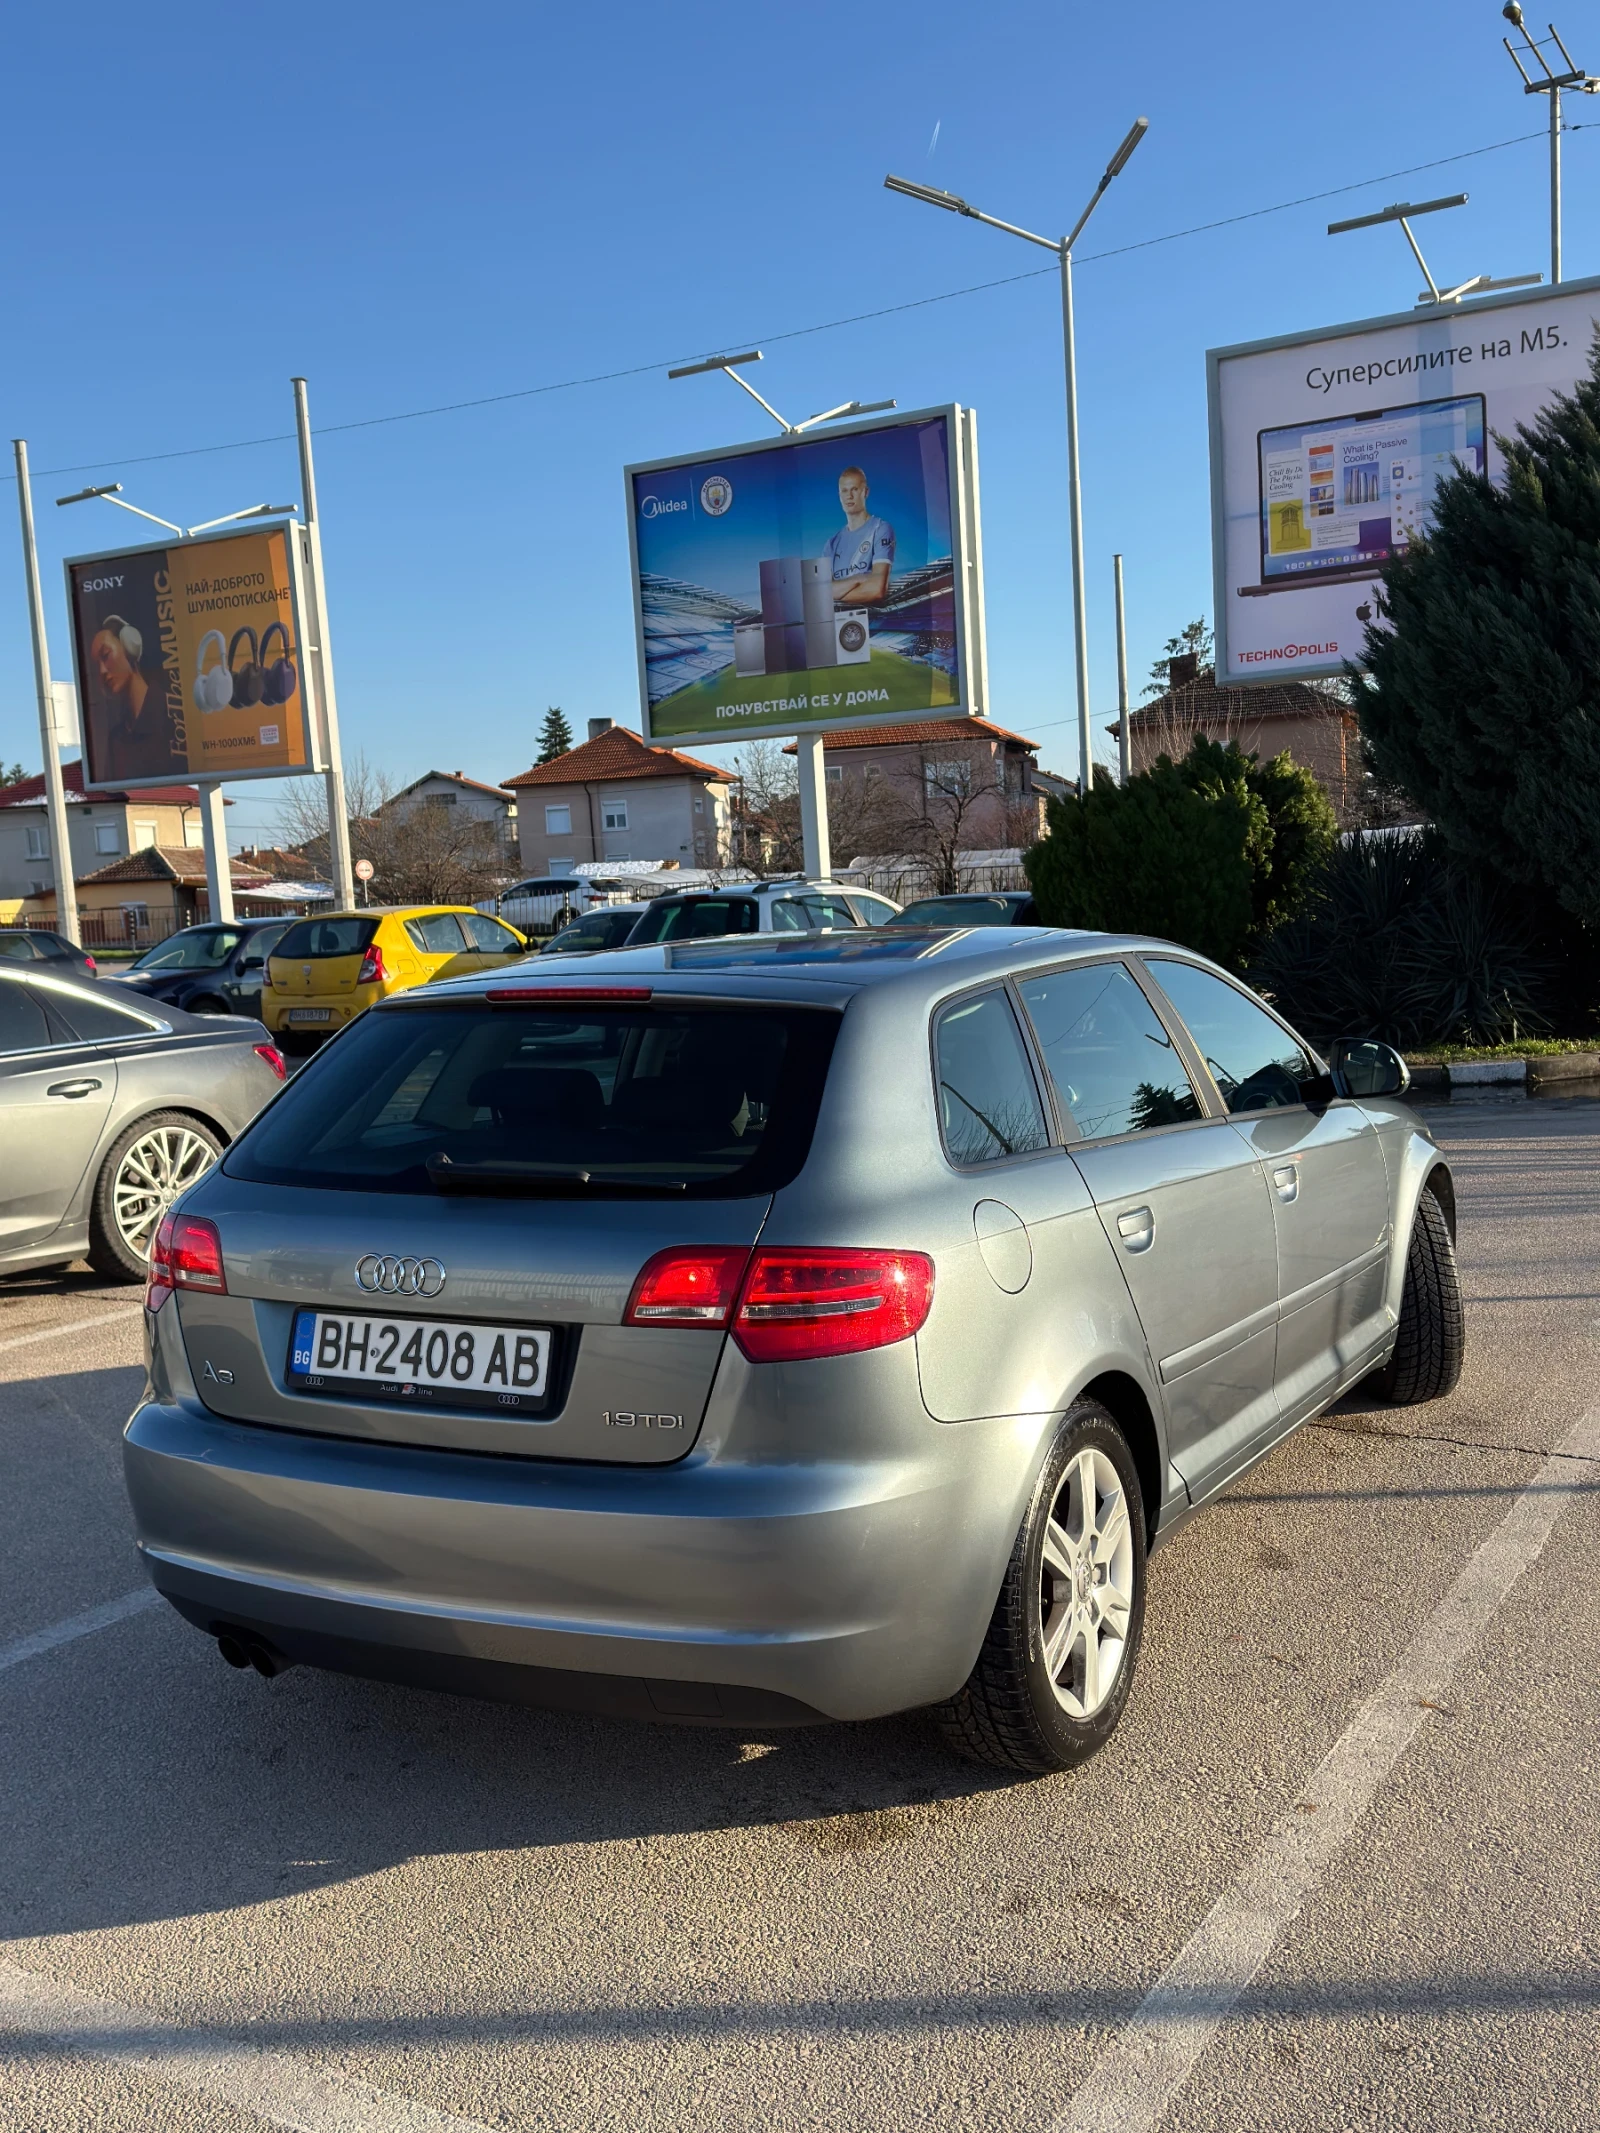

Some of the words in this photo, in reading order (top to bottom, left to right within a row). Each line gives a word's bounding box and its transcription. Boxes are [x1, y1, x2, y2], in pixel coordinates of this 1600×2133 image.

[1306, 345, 1472, 394] Суперсилите
[1482, 339, 1511, 360] на
[1521, 325, 1568, 354] M5.
[1343, 445, 1365, 455] What
[1366, 444, 1374, 452] is
[1375, 438, 1407, 449] Passive
[1344, 451, 1379, 464] Cooling?
[703, 477, 730, 493] MANCHESTER
[641, 495, 688, 518] Midea
[833, 561, 868, 579] ETIHAD
[83, 575, 125, 592] SONY
[186, 572, 265, 596] НАЙ-ДОБРОТО
[1238, 642, 1338, 663] TECHNOPOLIS
[716, 694, 808, 718] ПОЧУВСТВАЙ
[811, 694, 829, 708] СЕ
[833, 693, 842, 705] У
[846, 688, 889, 706] ДОМА
[202, 736, 256, 750] WH-1000XM6
[293, 1350, 310, 1365] BG
[375, 1325, 475, 1381] 2408
[483, 1334, 540, 1388] AB
[203, 1360, 234, 1384] A3
[380, 1383, 398, 1392] Audi
[418, 1387, 433, 1396] line
